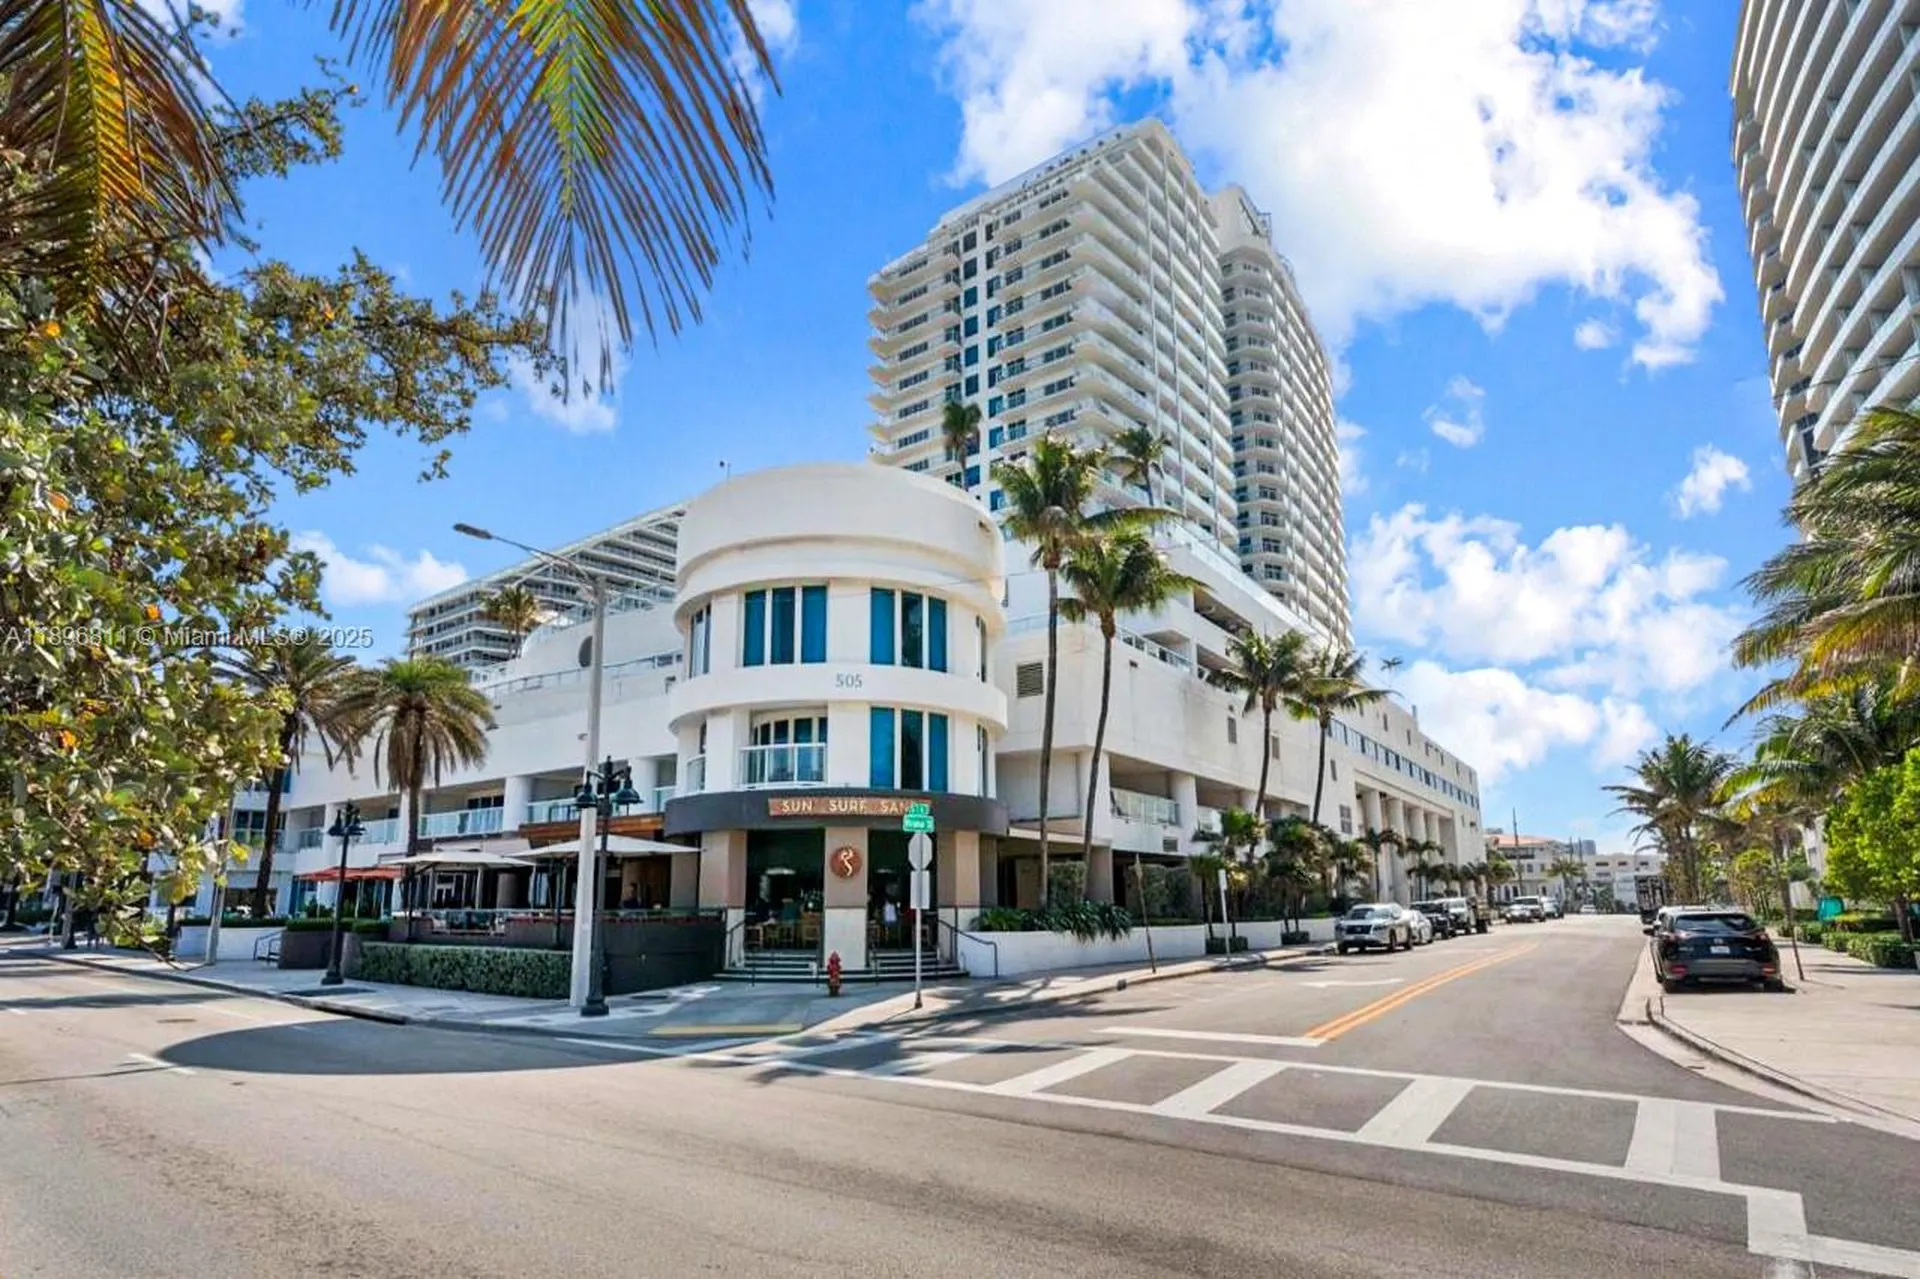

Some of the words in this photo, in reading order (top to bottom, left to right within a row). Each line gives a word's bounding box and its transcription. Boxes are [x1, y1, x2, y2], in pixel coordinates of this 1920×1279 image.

[835, 672, 863, 689] 505
[781, 799, 813, 813] SUN
[828, 799, 866, 813] SURF
[880, 801, 912, 816] SAN
